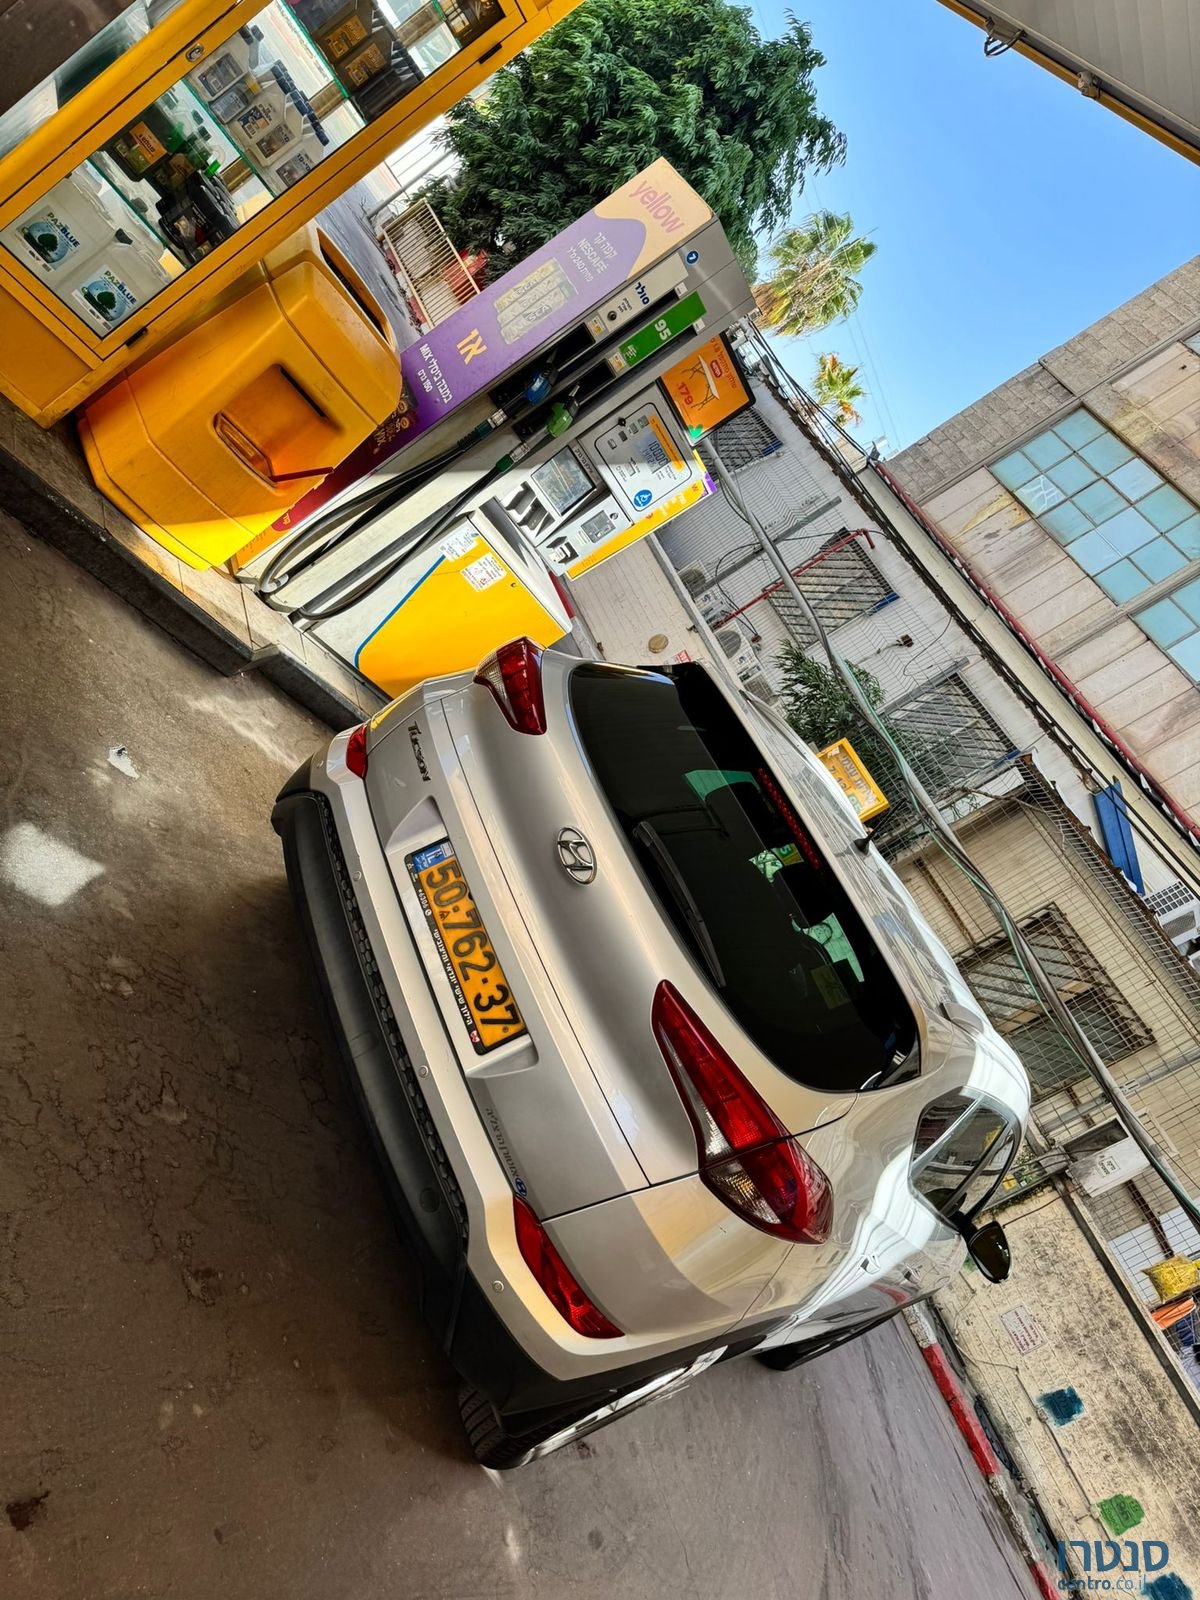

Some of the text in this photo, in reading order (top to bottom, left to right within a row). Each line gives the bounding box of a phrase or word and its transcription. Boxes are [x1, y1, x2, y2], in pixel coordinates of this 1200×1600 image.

[628, 179, 684, 234] yellow
[46, 211, 80, 247] PAZBLUE
[592, 231, 618, 259] קפה קר
[572, 255, 585, 270] 240
[103, 269, 137, 304] PAZBLUE
[633, 281, 650, 305] סולר
[653, 317, 672, 341] 95
[454, 327, 489, 365] או
[416, 368, 433, 392] 150 גרם
[418, 343, 453, 404] במבה ביסלי MIX
[676, 381, 694, 405] 179
[484, 1106, 505, 1145] הרצליה
